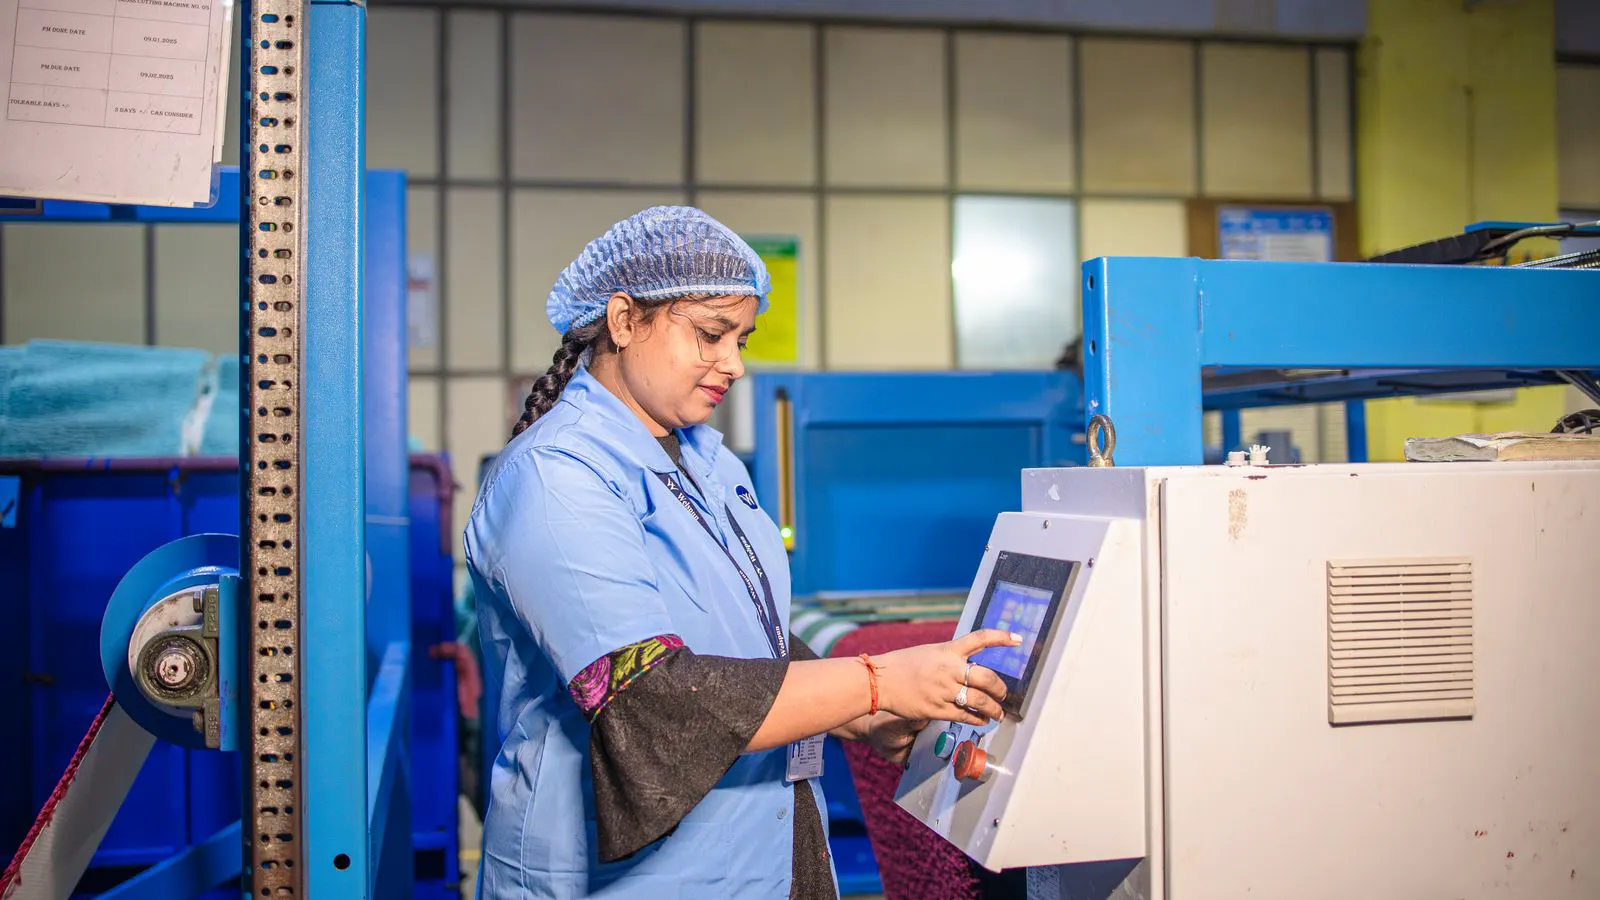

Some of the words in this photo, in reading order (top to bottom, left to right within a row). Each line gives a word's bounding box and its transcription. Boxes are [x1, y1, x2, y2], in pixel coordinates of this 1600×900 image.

[143, 36, 178, 44] 09.01.2025
[140, 72, 174, 80] 09.02.2025
[164, 111, 194, 119] CONSIDER
